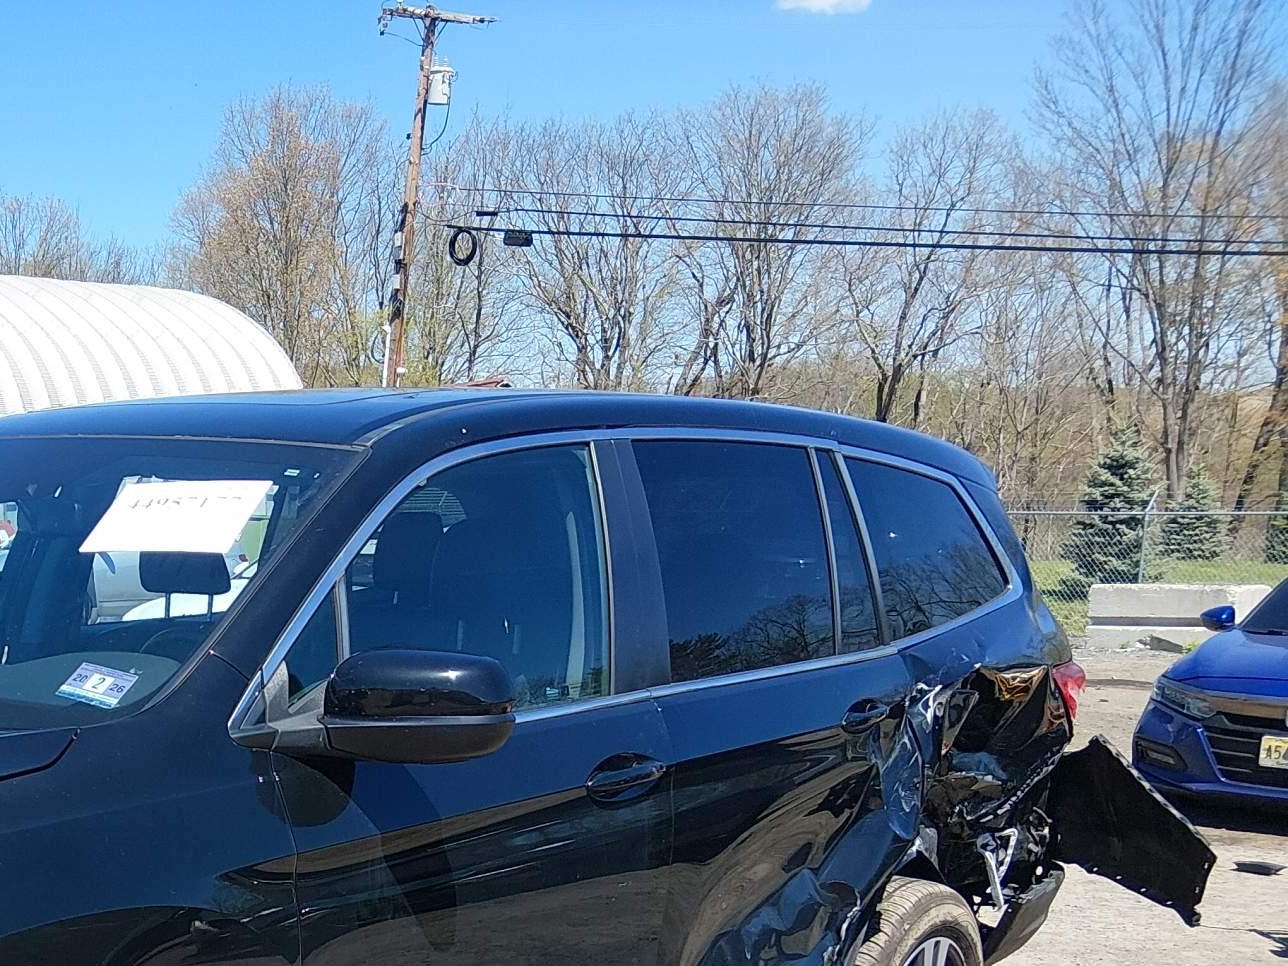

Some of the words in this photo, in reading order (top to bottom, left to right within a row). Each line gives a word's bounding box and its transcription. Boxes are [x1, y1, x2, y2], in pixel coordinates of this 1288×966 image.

[72, 673, 88, 683] 20
[92, 677, 106, 690] 2
[109, 683, 126, 693] 26
